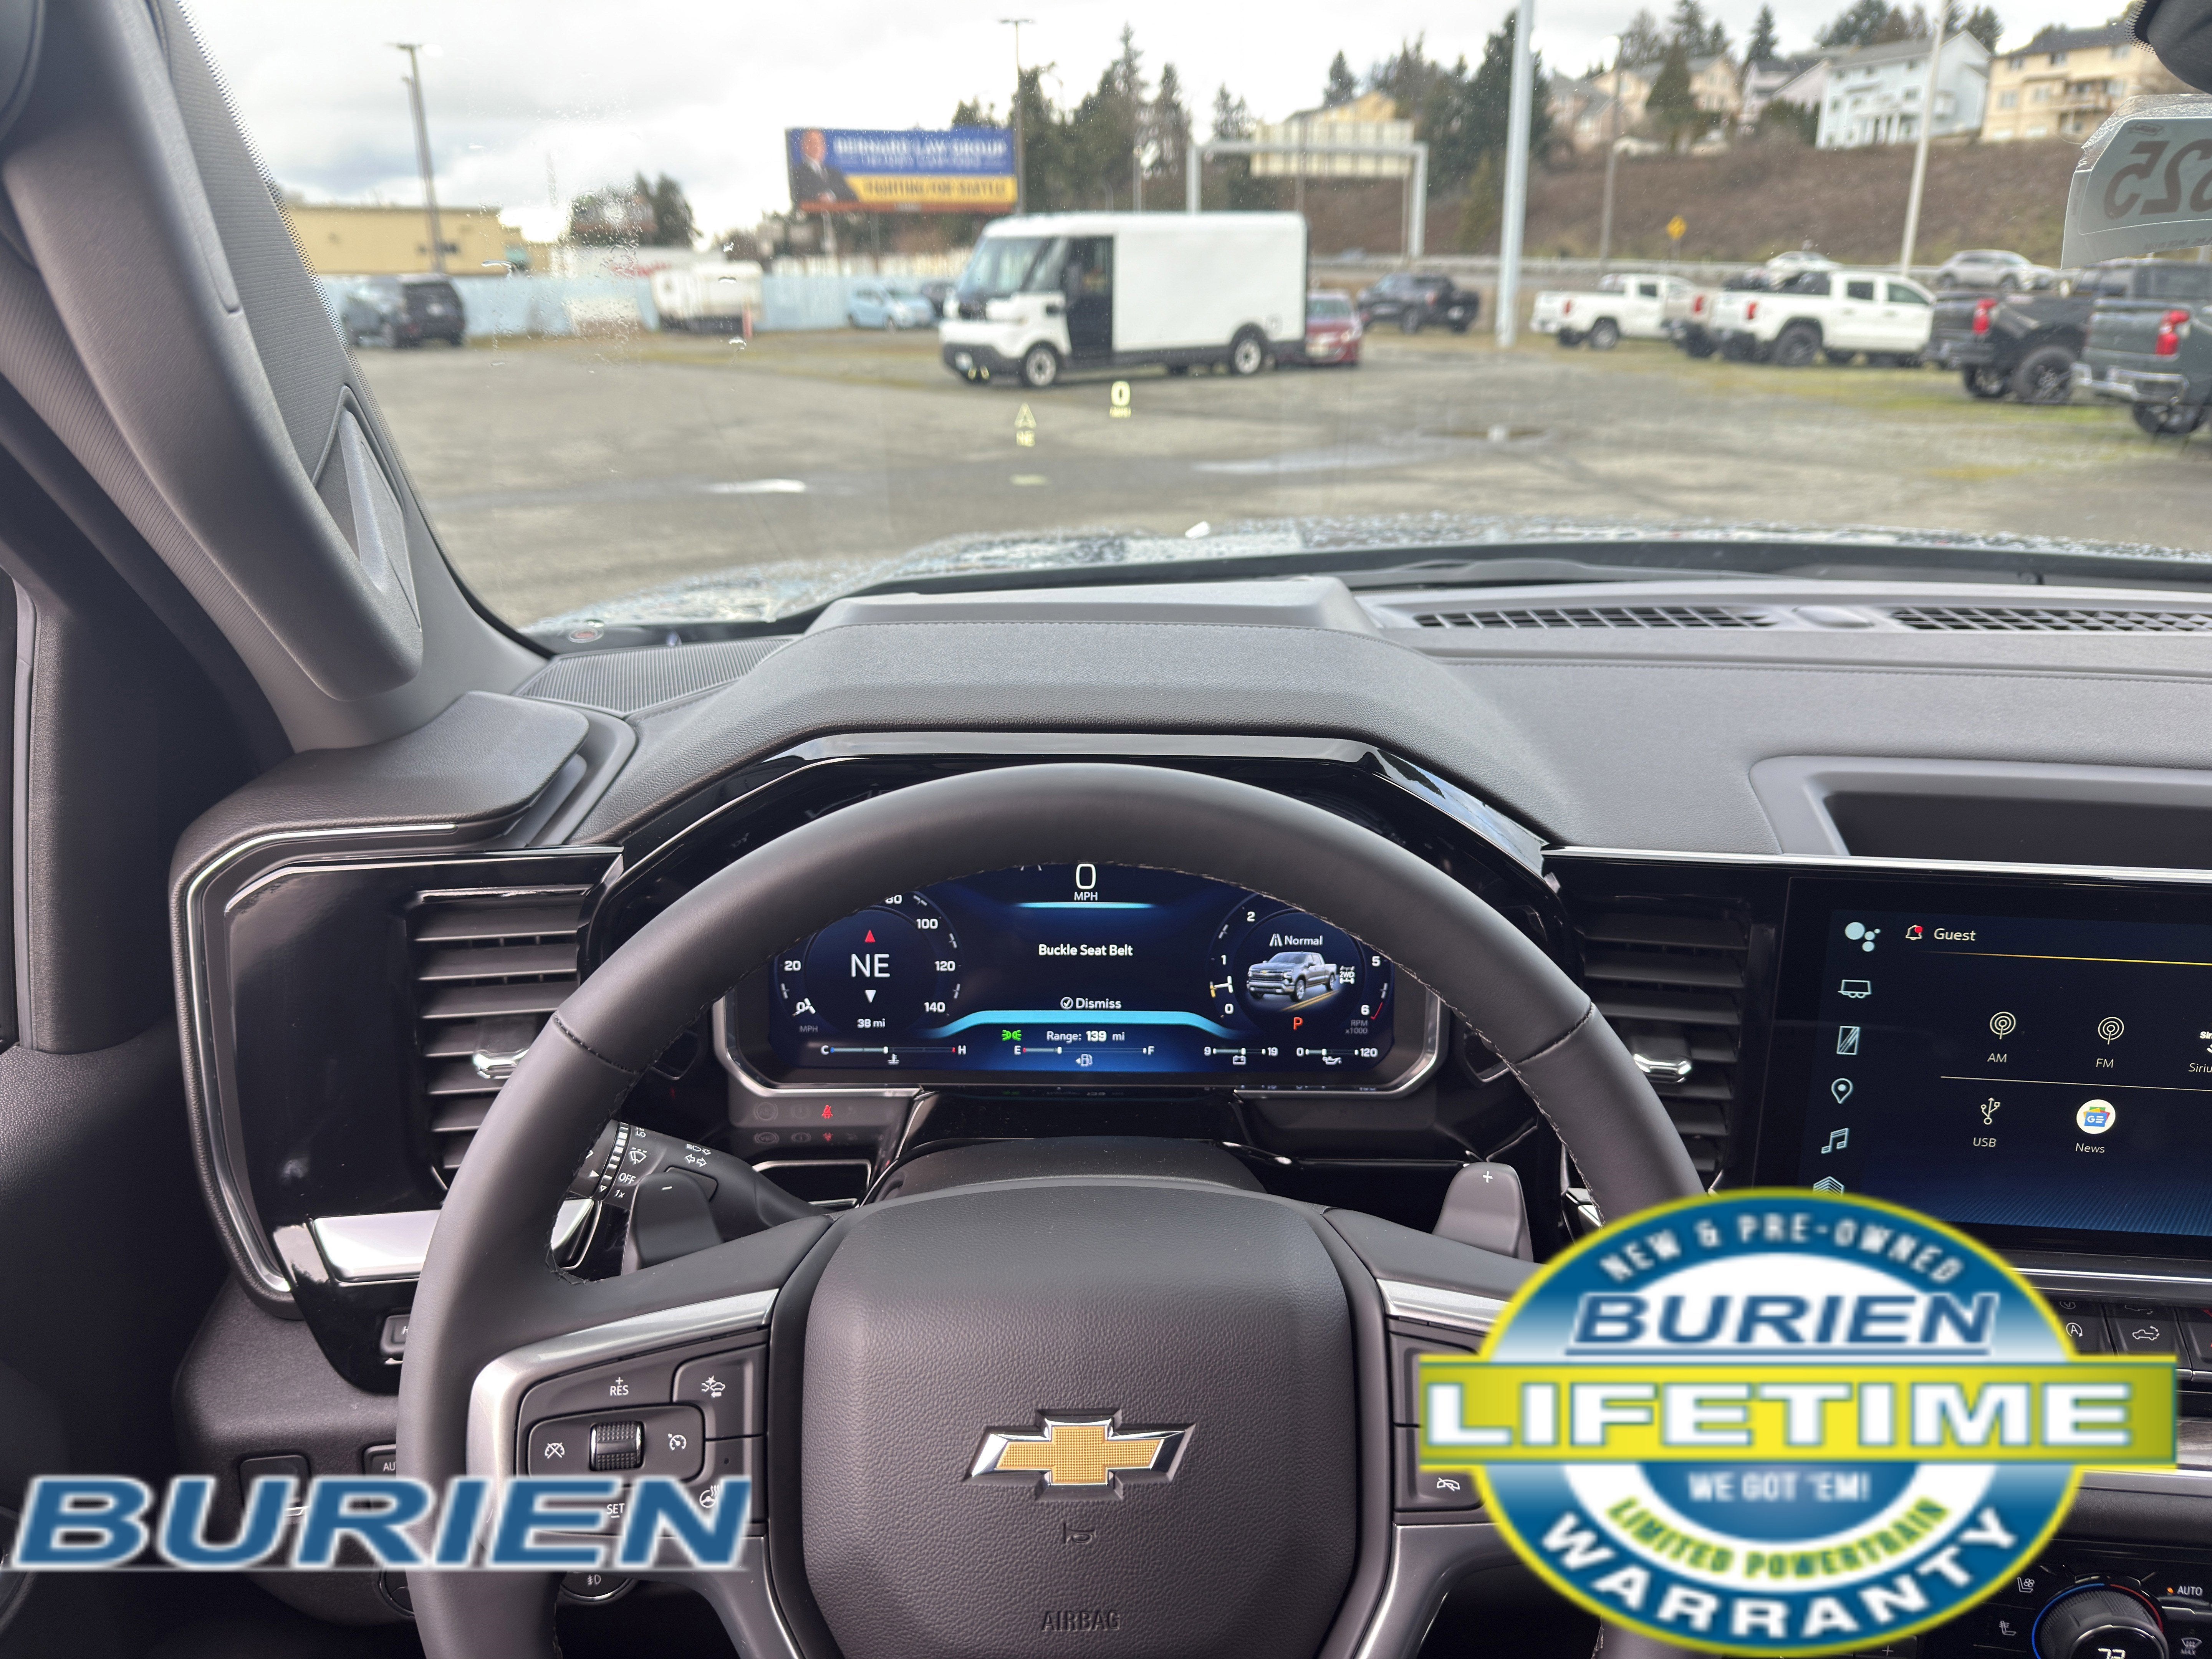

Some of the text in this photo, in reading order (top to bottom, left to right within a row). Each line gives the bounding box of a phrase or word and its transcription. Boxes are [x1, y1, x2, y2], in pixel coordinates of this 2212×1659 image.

[1076, 863, 1096, 889] 0
[1074, 892, 1098, 901] MPH
[1247, 911, 1255, 922] 2
[916, 918, 939, 929] 100
[1933, 927, 1977, 942] Guest
[1284, 935, 1324, 946] Normal
[1038, 944, 1133, 956] Buckle Seat Belt
[784, 960, 801, 971] 20
[1220, 955, 1227, 965] 1
[1371, 956, 1381, 967] 5
[851, 954, 891, 978] NE
[934, 961, 956, 972] 120
[1339, 970, 1355, 979] 2WD
[924, 1002, 946, 1013] 140
[1076, 997, 1122, 1009] Dismiss
[1224, 1003, 1234, 1014] 0
[1361, 1004, 1370, 1015] 6
[857, 1018, 886, 1028] 38 mi
[1293, 1017, 1303, 1031] P
[1046, 1031, 1125, 1043] Range: 139 mi
[820, 1045, 967, 1055] C H
[1014, 1045, 1155, 1055] E F
[1204, 1047, 1279, 1057] 9 19
[1296, 1047, 1378, 1058] 0 120
[1987, 1053, 2008, 1064] AM
[2095, 1058, 2114, 1069] FM
[1972, 1137, 1997, 1148] USB
[2075, 1142, 2105, 1153] News
[619, 1172, 636, 1184] OFF
[609, 1385, 629, 1396] RES
[606, 1503, 625, 1515] SET
[2177, 1586, 2203, 1596] AUTO
[1041, 1612, 1120, 1632] AIRBAG
